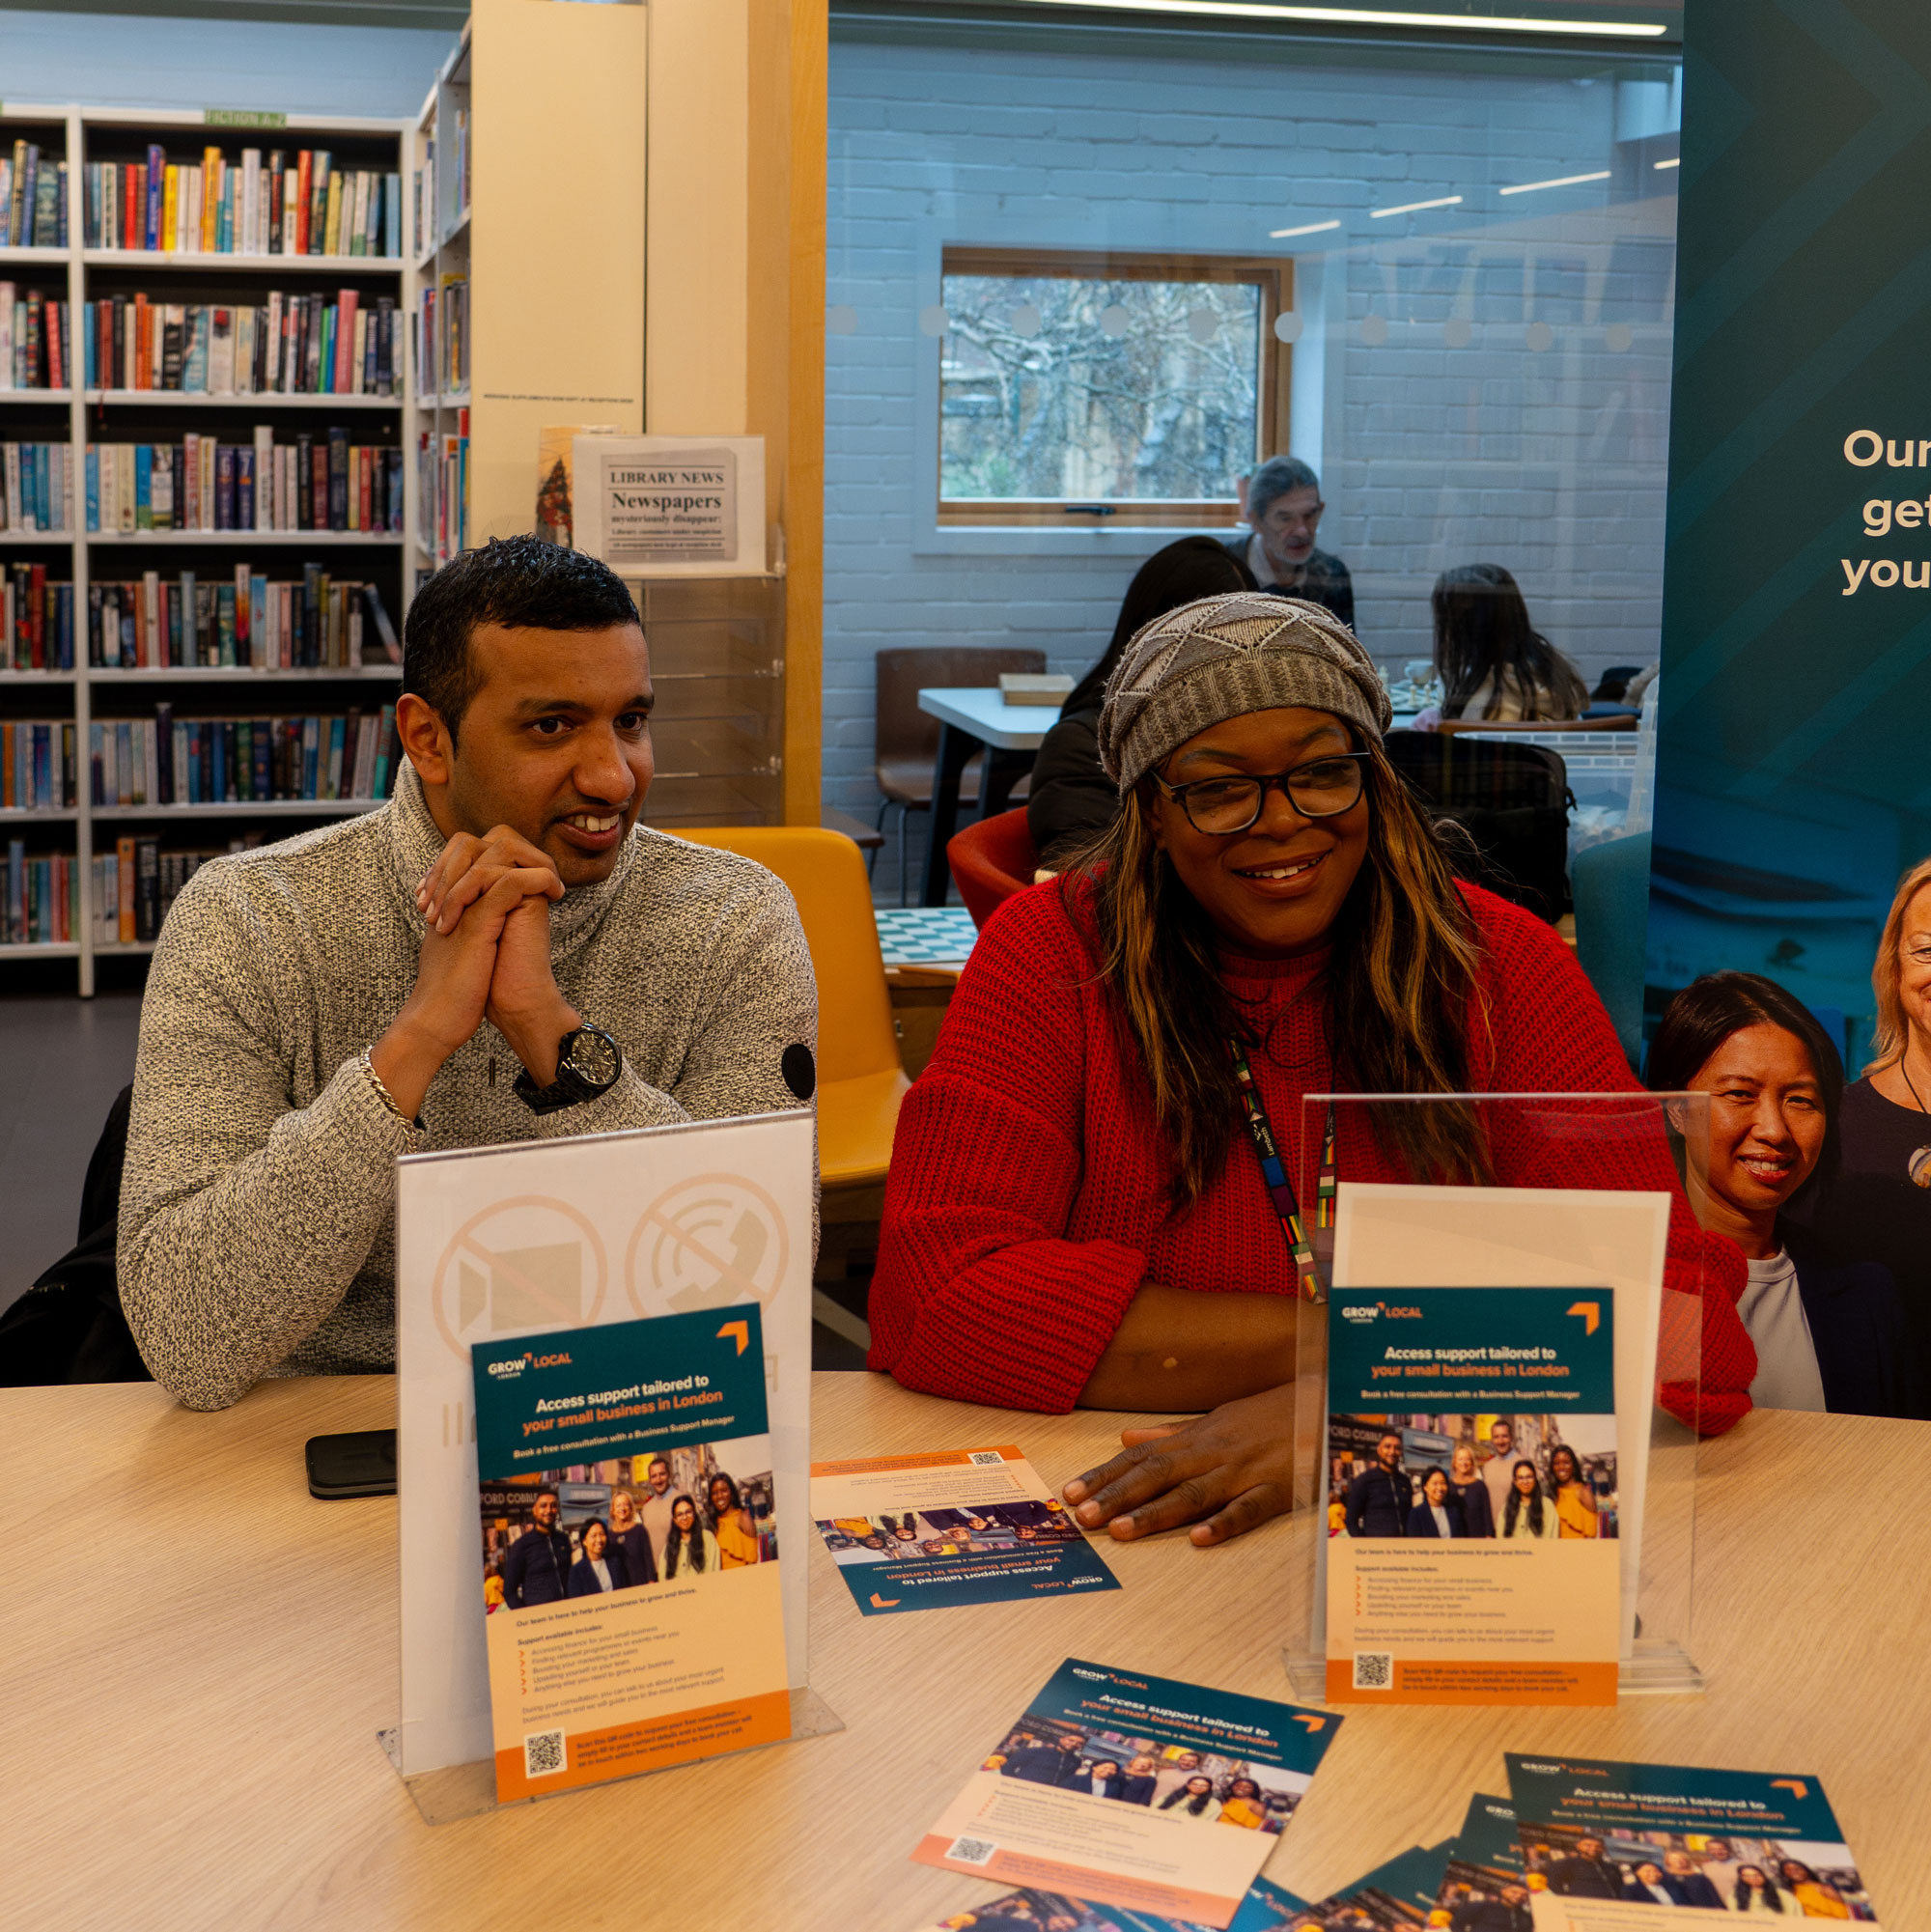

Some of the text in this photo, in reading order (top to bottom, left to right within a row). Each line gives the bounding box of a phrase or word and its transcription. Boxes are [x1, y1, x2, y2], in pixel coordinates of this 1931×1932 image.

[1843, 429, 1931, 467] Our
[610, 471, 724, 484] LIBRARY NEWS
[612, 492, 722, 512] Newspapers
[611, 515, 670, 525] mysteriously
[1261, 1126, 1275, 1156] Lambeth
[1342, 1306, 1422, 1318] GROW LOCAL
[1384, 1346, 1556, 1361] Access support tailored to
[488, 1352, 571, 1374] GROW LOCAL
[1371, 1363, 1570, 1379] your small business in London
[535, 1375, 709, 1412] Access support tailored to
[522, 1391, 722, 1436] your small business in London
[512, 1448, 534, 1458] Book
[542, 1445, 559, 1453] free
[559, 1436, 608, 1450] consultation
[609, 1432, 627, 1442] with
[633, 1426, 668, 1438] Business
[669, 1420, 700, 1432] Support
[700, 1415, 734, 1426] Manager
[886, 1571, 932, 1579] London
[946, 1564, 999, 1573] business
[963, 1570, 1009, 1579] support
[916, 1574, 962, 1584] tailored
[1071, 1668, 1148, 1689] GROW LOCAL
[1098, 1695, 1146, 1710] Access
[1148, 1706, 1200, 1721] support
[1202, 1717, 1254, 1732] tailored
[1079, 1700, 1278, 1747] your small business in London
[1485, 1804, 1516, 1817] GRO
